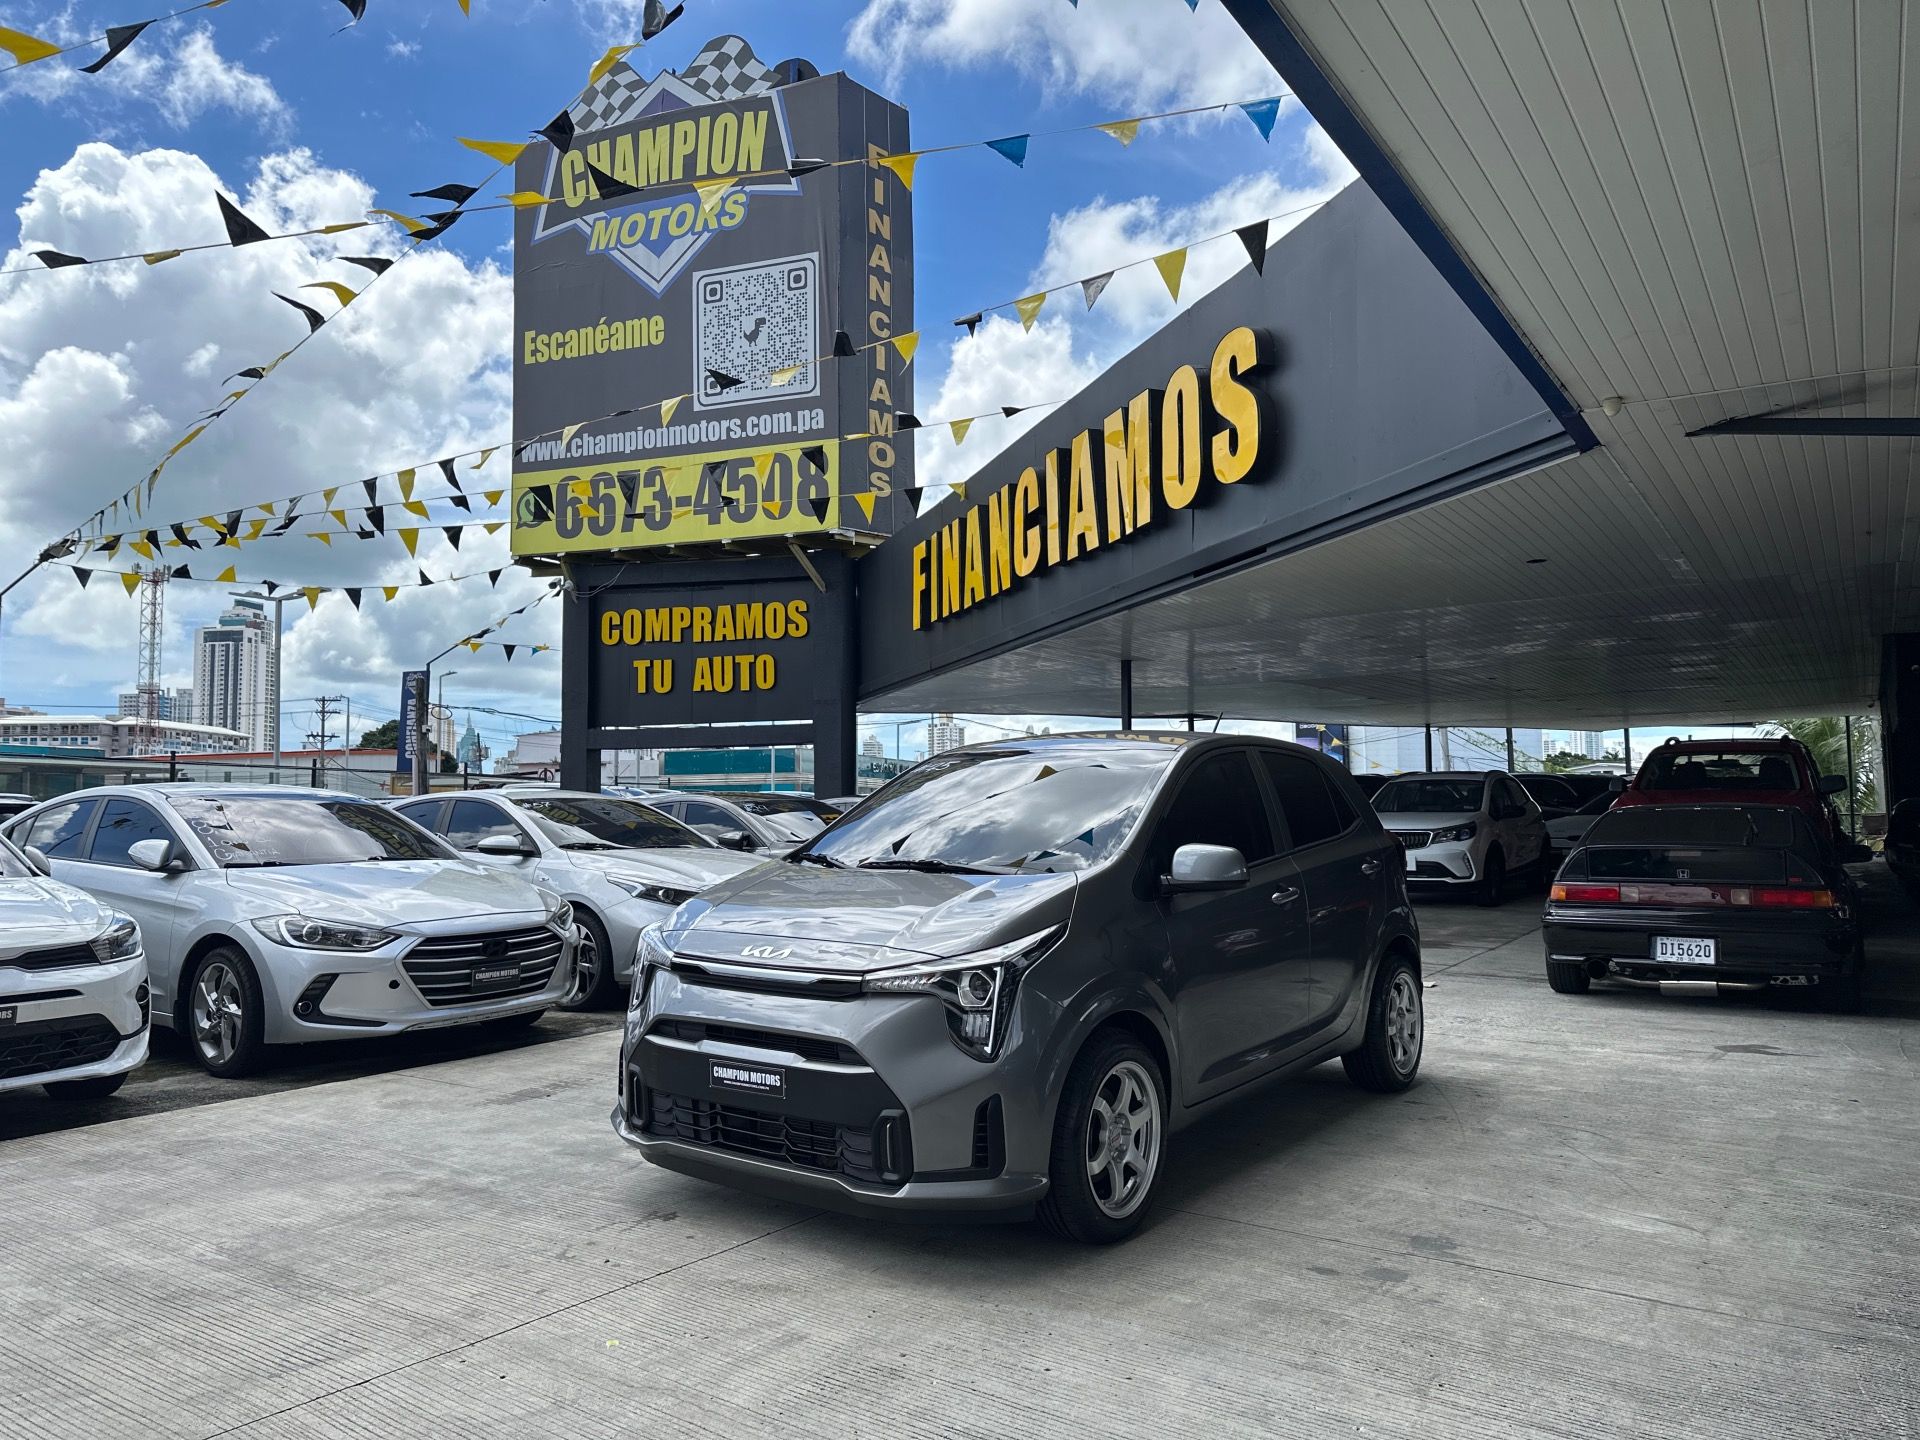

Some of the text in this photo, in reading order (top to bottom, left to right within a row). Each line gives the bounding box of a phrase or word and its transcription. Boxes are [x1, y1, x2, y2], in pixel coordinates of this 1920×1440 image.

[561, 110, 768, 208] CHAMPION
[589, 192, 747, 252] MOTORS
[524, 315, 665, 365] Escanéame
[868, 142, 896, 498] FINANCIAMOS
[521, 408, 825, 463] www.championmotors.com.pa
[555, 450, 830, 539] 6673-4508
[912, 326, 1259, 631] FINANCIAMOS
[601, 600, 809, 646] COMPRAMOS
[633, 653, 775, 694] TU AUTO
[1660, 942, 1711, 958] DI5620
[713, 1066, 750, 1081] CHAMPION
[750, 1072, 781, 1086] MOTORS
